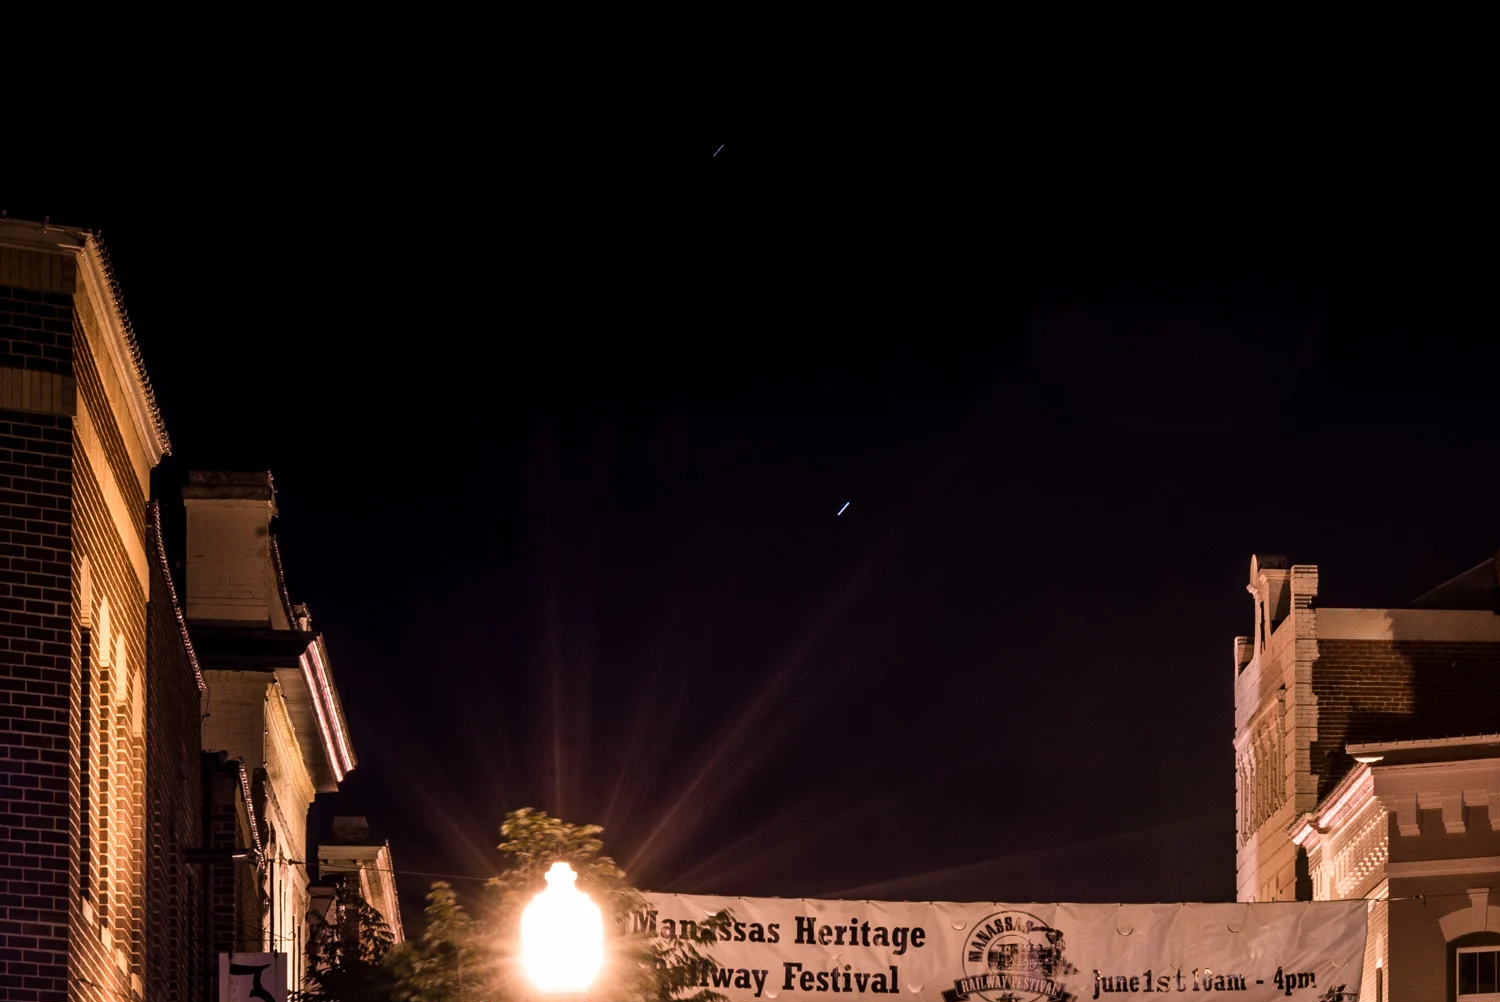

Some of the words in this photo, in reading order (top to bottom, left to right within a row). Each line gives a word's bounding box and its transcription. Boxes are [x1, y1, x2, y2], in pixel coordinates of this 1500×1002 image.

[633, 910, 780, 944] Manassas
[794, 915, 926, 956] Heritage
[968, 916, 1035, 963] MANASSAS
[782, 961, 900, 994] Festival
[961, 975, 1008, 994] RAILWAY
[1010, 975, 1058, 997] FESTIVAL
[1273, 966, 1317, 997] 4pm
